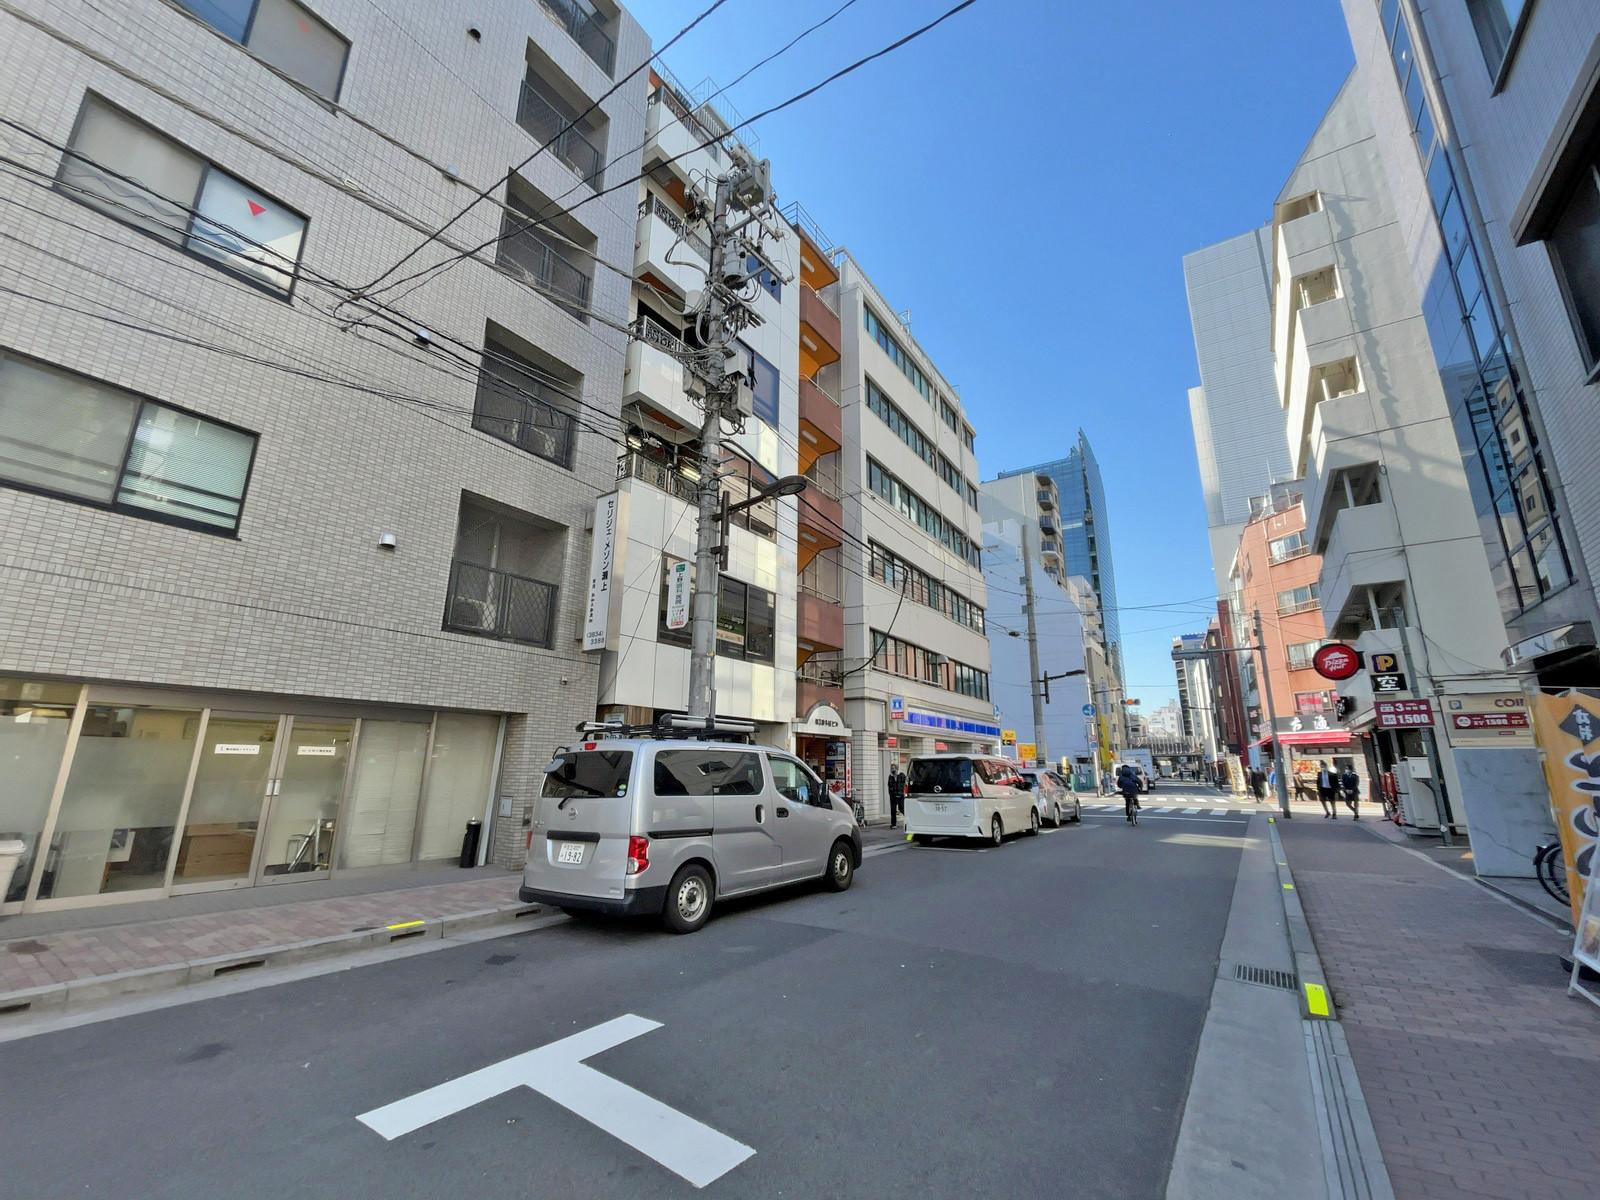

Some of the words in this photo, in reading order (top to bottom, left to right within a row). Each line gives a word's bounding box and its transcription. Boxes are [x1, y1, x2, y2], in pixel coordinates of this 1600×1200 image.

[1329, 663, 1347, 672] Hut
[1377, 675, 1401, 691] 空
[563, 851, 582, 862] 19-82
